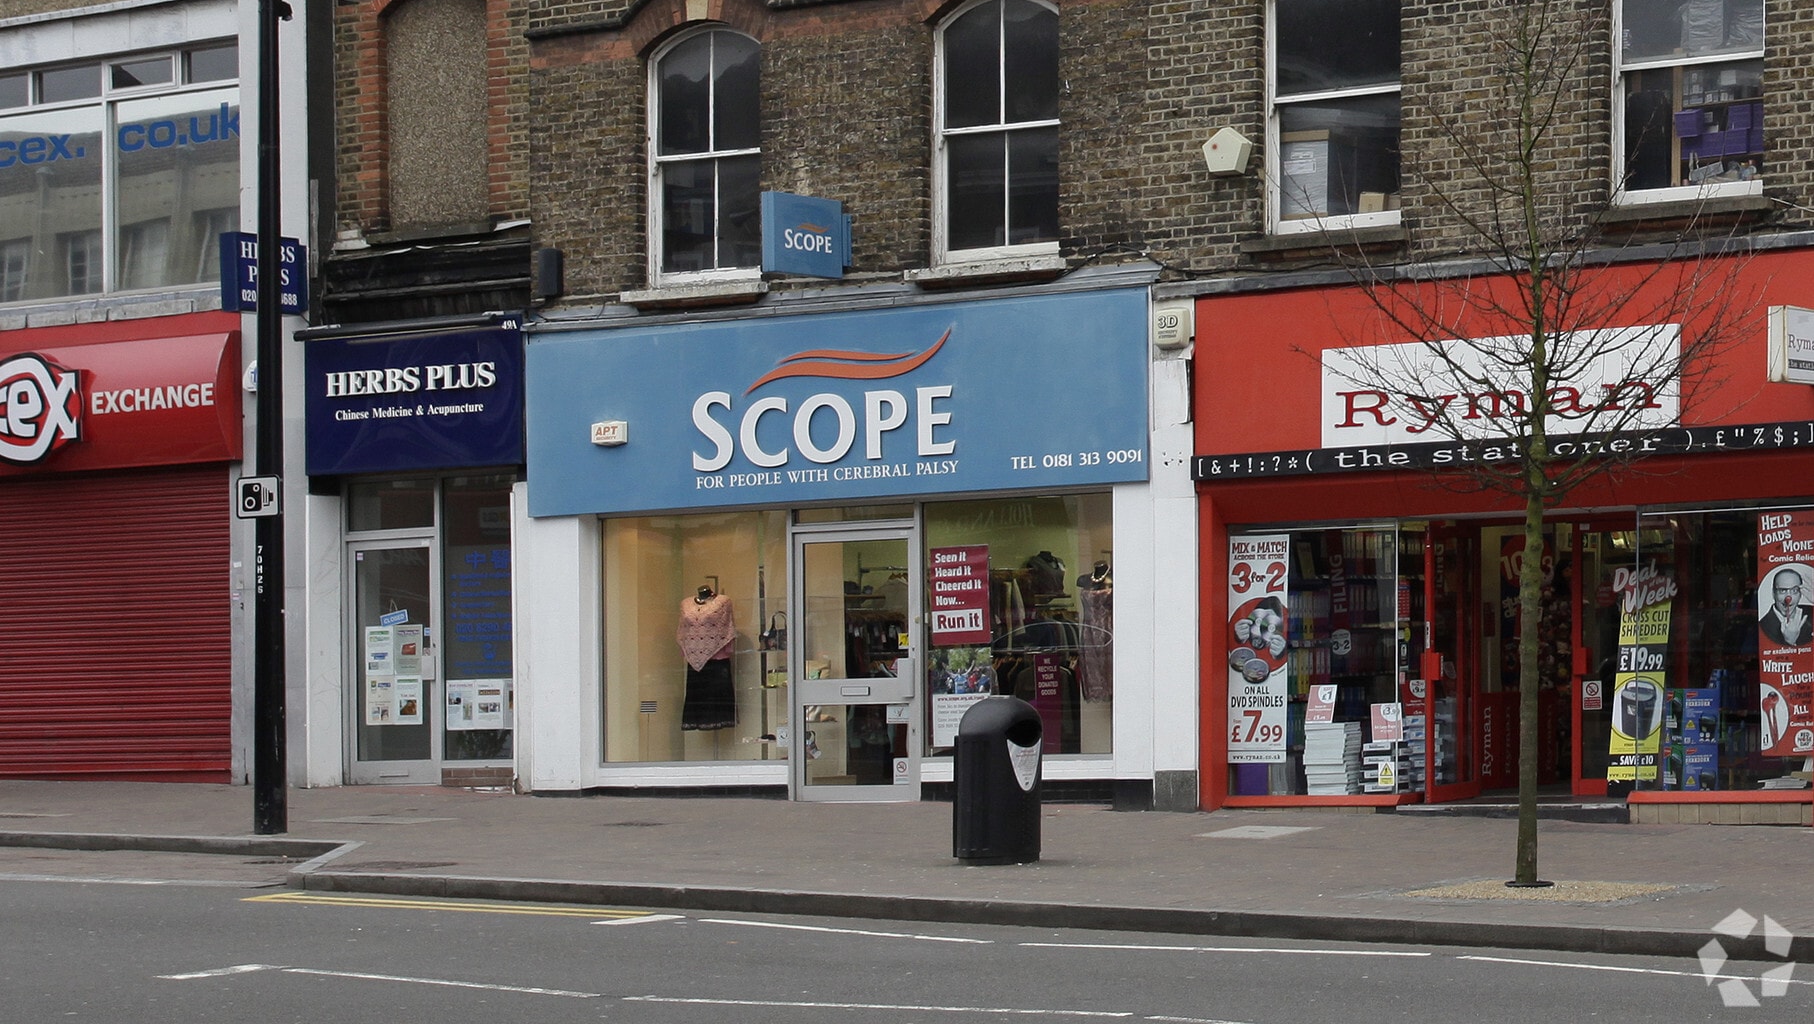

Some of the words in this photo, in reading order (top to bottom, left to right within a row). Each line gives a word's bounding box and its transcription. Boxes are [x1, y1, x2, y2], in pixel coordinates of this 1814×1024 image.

[784, 229, 833, 254] SCOPE
[501, 320, 517, 329] 49A
[1158, 315, 1178, 328] 3D
[326, 366, 420, 397] HERBS
[425, 362, 496, 391] PLUS
[91, 382, 214, 415] EXCHANGE
[335, 410, 369, 421] Chinese
[373, 406, 413, 418] Medicine
[416, 405, 424, 415] &
[427, 402, 484, 416] Acupuncture
[1335, 380, 1662, 433] Ryman
[595, 426, 618, 436] APT
[691, 385, 956, 472] SCOPE
[1011, 456, 1036, 469] TEL
[1042, 453, 1073, 468] 0181
[1079, 452, 1100, 466] 313
[1106, 449, 1142, 464] 9091
[1334, 449, 1410, 469] the
[696, 475, 724, 490] FOR
[729, 472, 782, 487] PEOPLE
[787, 469, 828, 483] WITH
[833, 463, 911, 481] CEREBRAL
[916, 460, 960, 476] PALSY
[1761, 514, 1792, 530] HELP
[1759, 529, 1791, 546] LOADS
[1231, 542, 1250, 554] MIX
[1257, 541, 1287, 554] MATCH
[935, 553, 958, 563] Seen
[959, 552, 967, 562] it
[1768, 555, 1794, 563] Comic
[934, 567, 962, 578] Heard
[964, 566, 972, 576] it
[1231, 561, 1252, 594] 3
[1251, 571, 1266, 583] for
[1265, 561, 1287, 594] 2
[1613, 558, 1658, 592] Deal
[935, 581, 973, 592] Cheered
[974, 579, 982, 589] it
[1329, 554, 1348, 613] FILING
[935, 595, 965, 606] Now...
[1625, 577, 1679, 613] Week
[937, 614, 965, 630] Run
[969, 612, 980, 628] it
[1652, 610, 1669, 622] CUT
[1621, 623, 1668, 637] SHREDDER
[1620, 646, 1664, 671] £19.99
[1037, 665, 1057, 673] RECYCLE
[1762, 660, 1793, 673] WRITE
[1041, 672, 1055, 680] YOUR
[1781, 672, 1814, 687] LAUGH
[1038, 681, 1058, 689] DONATED
[1244, 686, 1255, 695] ON
[1256, 686, 1270, 695] ALL
[1231, 696, 1247, 708] DVD
[1248, 695, 1284, 708] SPINDLES
[1793, 704, 1809, 715] ALL
[1231, 709, 1283, 743] £7.99
[1481, 705, 1494, 776] Ryman
[1641, 755, 1654, 765] £10
